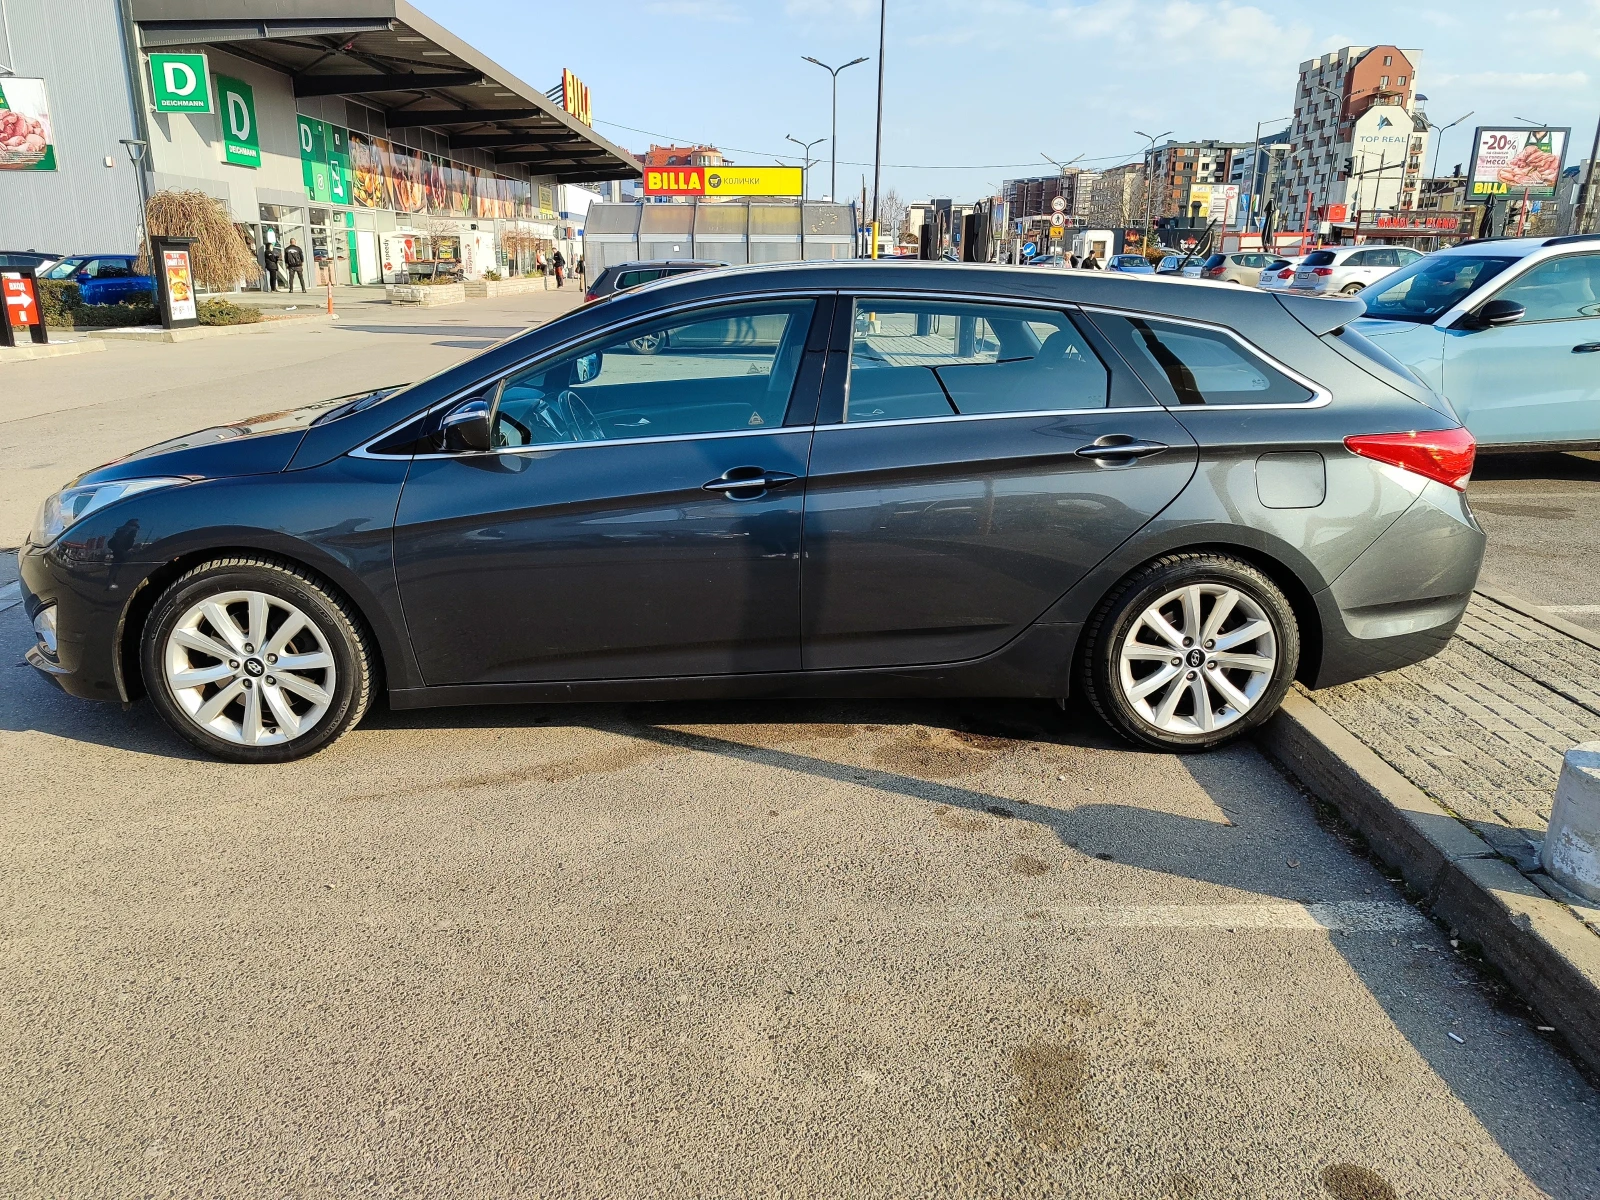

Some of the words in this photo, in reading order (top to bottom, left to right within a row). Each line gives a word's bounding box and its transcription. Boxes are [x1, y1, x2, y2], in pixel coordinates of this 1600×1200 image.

[563, 68, 592, 129] BILLA
[1360, 135, 1379, 143] TOP
[1382, 135, 1406, 143] REAL
[1482, 134, 1517, 150] -20%
[228, 144, 257, 158] DEICHMANN
[647, 172, 701, 190] BILLA
[723, 177, 760, 185] КОЛИЧКИ
[1473, 182, 1508, 194] BILLA
